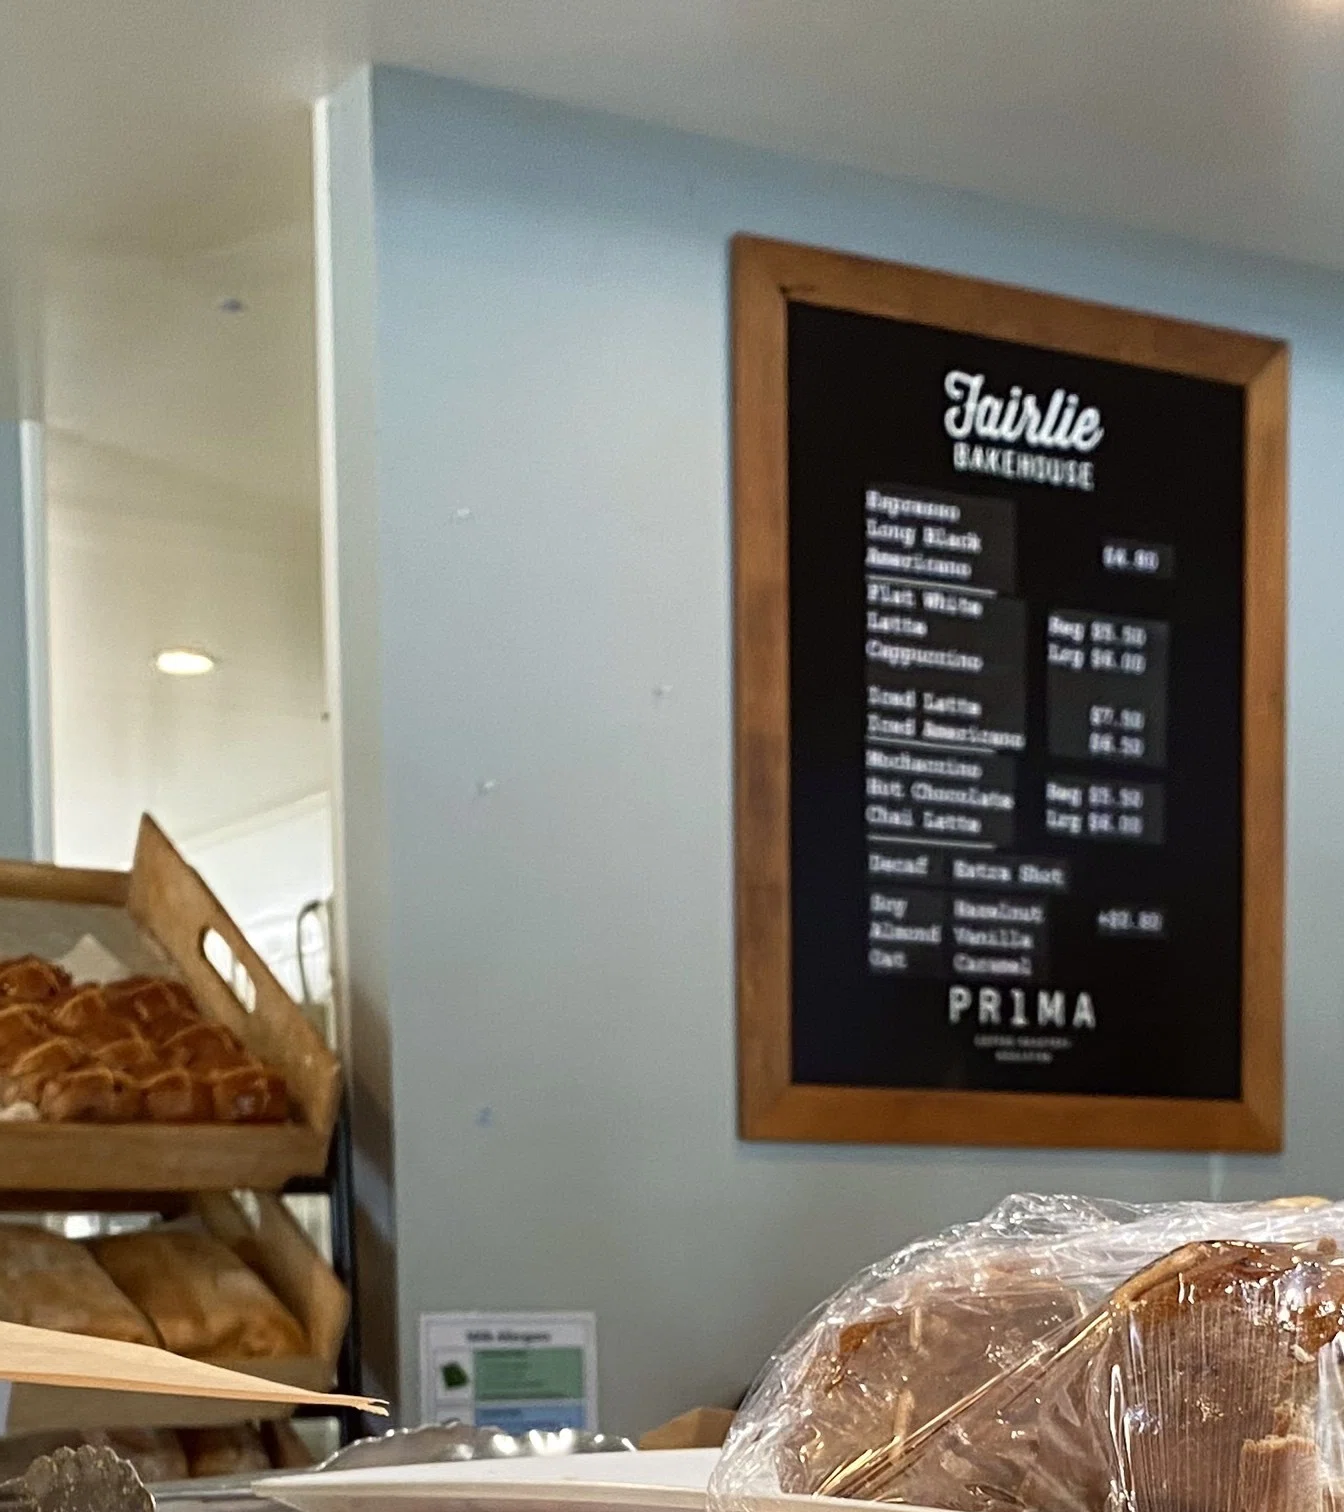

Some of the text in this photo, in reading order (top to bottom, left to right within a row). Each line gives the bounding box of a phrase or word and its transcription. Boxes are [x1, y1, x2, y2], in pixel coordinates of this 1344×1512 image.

[944, 369, 1104, 452] Fairlie
[953, 441, 1095, 491] BAKEHOUSE
[865, 490, 961, 523] Espresso
[865, 518, 982, 554] Long Black
[865, 547, 972, 579] Americano
[867, 584, 983, 617] Flat White
[867, 611, 928, 637] Latte
[865, 639, 984, 672] Cappuccino
[868, 685, 982, 717] Iced Latte
[868, 714, 1026, 749] Iced Americano
[865, 778, 1016, 810] Hot Chocolate
[865, 805, 982, 834] Chai Latte
[868, 854, 1066, 886] Decaf Extra Shot
[870, 893, 908, 919] Soy
[953, 899, 1044, 924] Hazelnut
[869, 921, 942, 945] Almond
[953, 927, 1034, 949] Vanilla
[868, 948, 908, 969] Oat
[953, 953, 1032, 976] Caramel
